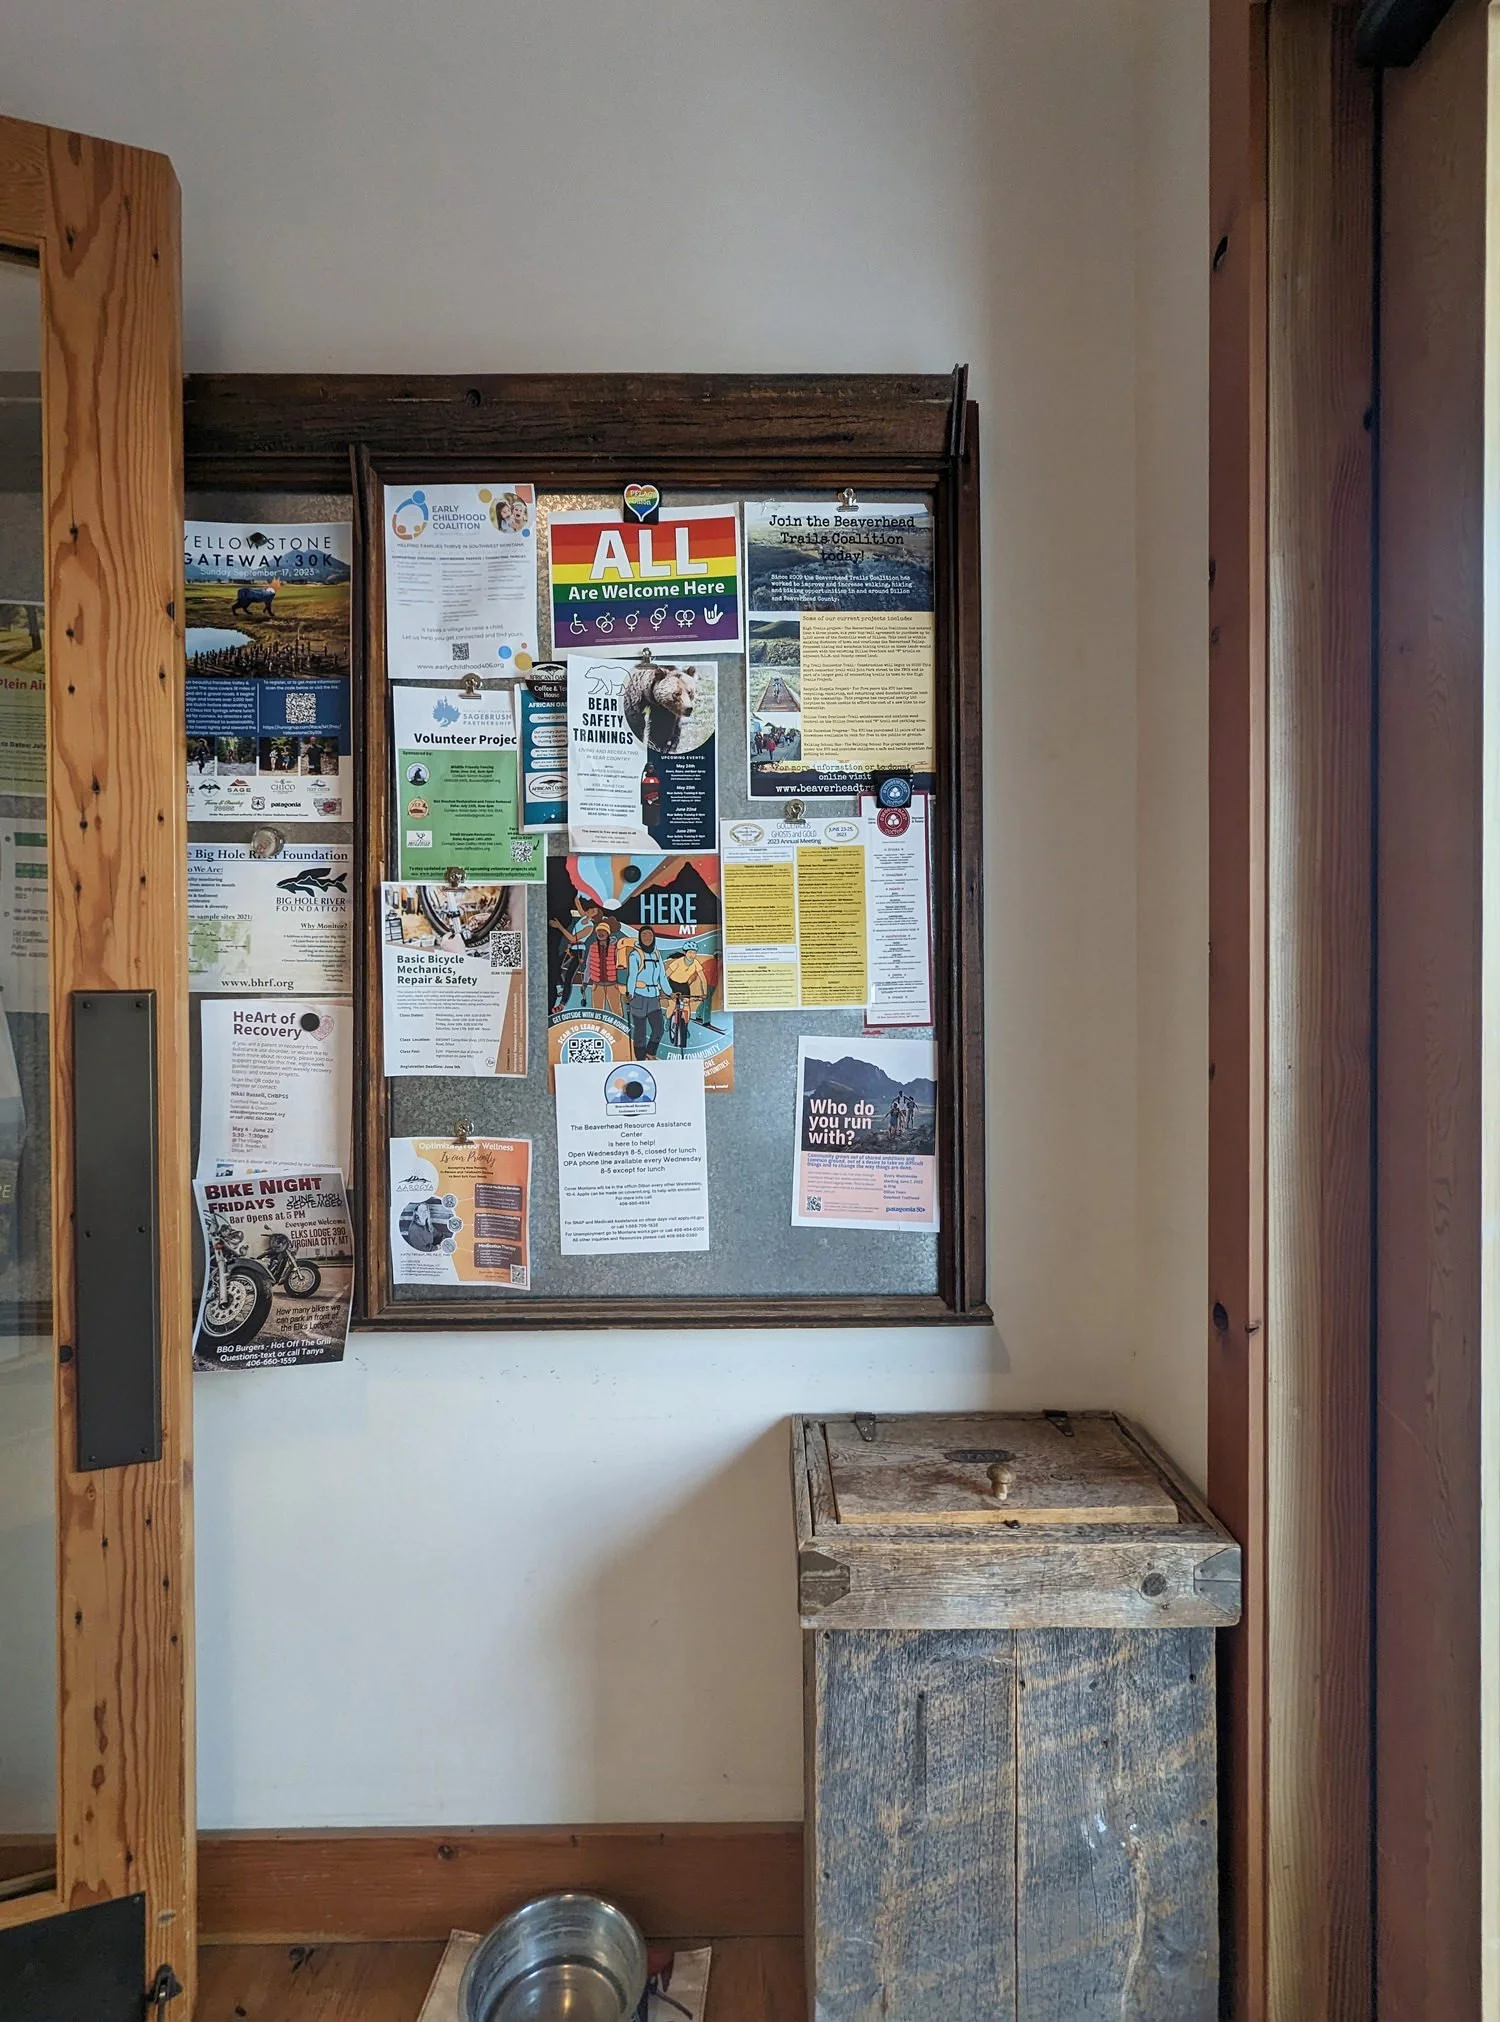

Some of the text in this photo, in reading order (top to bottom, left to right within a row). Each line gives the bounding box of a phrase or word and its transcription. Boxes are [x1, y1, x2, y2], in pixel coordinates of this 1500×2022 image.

[432, 505, 459, 513] EARLY
[432, 513, 486, 521] CHILDHOOD
[769, 515, 915, 528] Join the Beaverhead
[433, 522, 480, 530] COALITION
[780, 532, 903, 544] Trails Coalition
[184, 553, 332, 566] GATEWAY 30K
[589, 527, 708, 580] ALL
[822, 550, 864, 563] today!
[201, 569, 231, 578] Sunday
[234, 569, 277, 578] September
[568, 581, 725, 600] Are Welcome Here
[588, 697, 618, 712] BEAR
[582, 714, 624, 727] SAFETY
[414, 733, 517, 746] Volunteer Projec
[573, 728, 634, 745] TRAININGS
[196, 850, 214, 862] Big
[218, 850, 245, 859] Hole
[283, 851, 348, 860] Foundation
[640, 893, 697, 924] HERE
[679, 925, 697, 935] MT
[397, 955, 464, 964] Basic Bicycle
[397, 965, 456, 976] Mechanics,
[222, 978, 294, 990] www.bhrf.org
[397, 975, 477, 986] Repair & Safety
[233, 1012, 296, 1024] HeArt of
[553, 1016, 561, 1024] GET
[602, 1014, 614, 1023] YEAR
[233, 1024, 302, 1040] Recovery
[558, 1029, 571, 1044] SCAN
[580, 1024, 600, 1032] LEARN
[600, 1029, 616, 1044] MORE
[667, 1043, 720, 1060] FIND COMMUNITY
[810, 1099, 874, 1116] Who do
[808, 1116, 871, 1130] you run
[808, 1129, 855, 1145] with?
[587, 1149, 629, 1157] Wednesdays
[440, 1151, 496, 1168] Is our Priority
[205, 1178, 322, 1200] BIKE NIGHT
[287, 1194, 314, 1202] JUNE
[208, 1199, 275, 1214] FRIDAYS
[287, 1200, 342, 1210] SEPTEMBER
[229, 1214, 244, 1224] Bar
[247, 1213, 273, 1223] Opens
[275, 1212, 285, 1220] at
[294, 1210, 305, 1218] PM
[285, 1221, 316, 1229] Everyone
[291, 1227, 345, 1239] ELKS LODGE 390
[289, 1236, 348, 1249] VIRGINIA CITY, MT
[292, 1307, 310, 1315] many
[290, 1315, 305, 1323] park
[294, 1322, 308, 1331] Elks
[216, 1346, 234, 1354] BBQ
[236, 1344, 264, 1352] Burgers
[286, 1340, 299, 1348] Off
[220, 1351, 276, 1362] Questions-text
[246, 1357, 297, 1367] 406-660-1559
